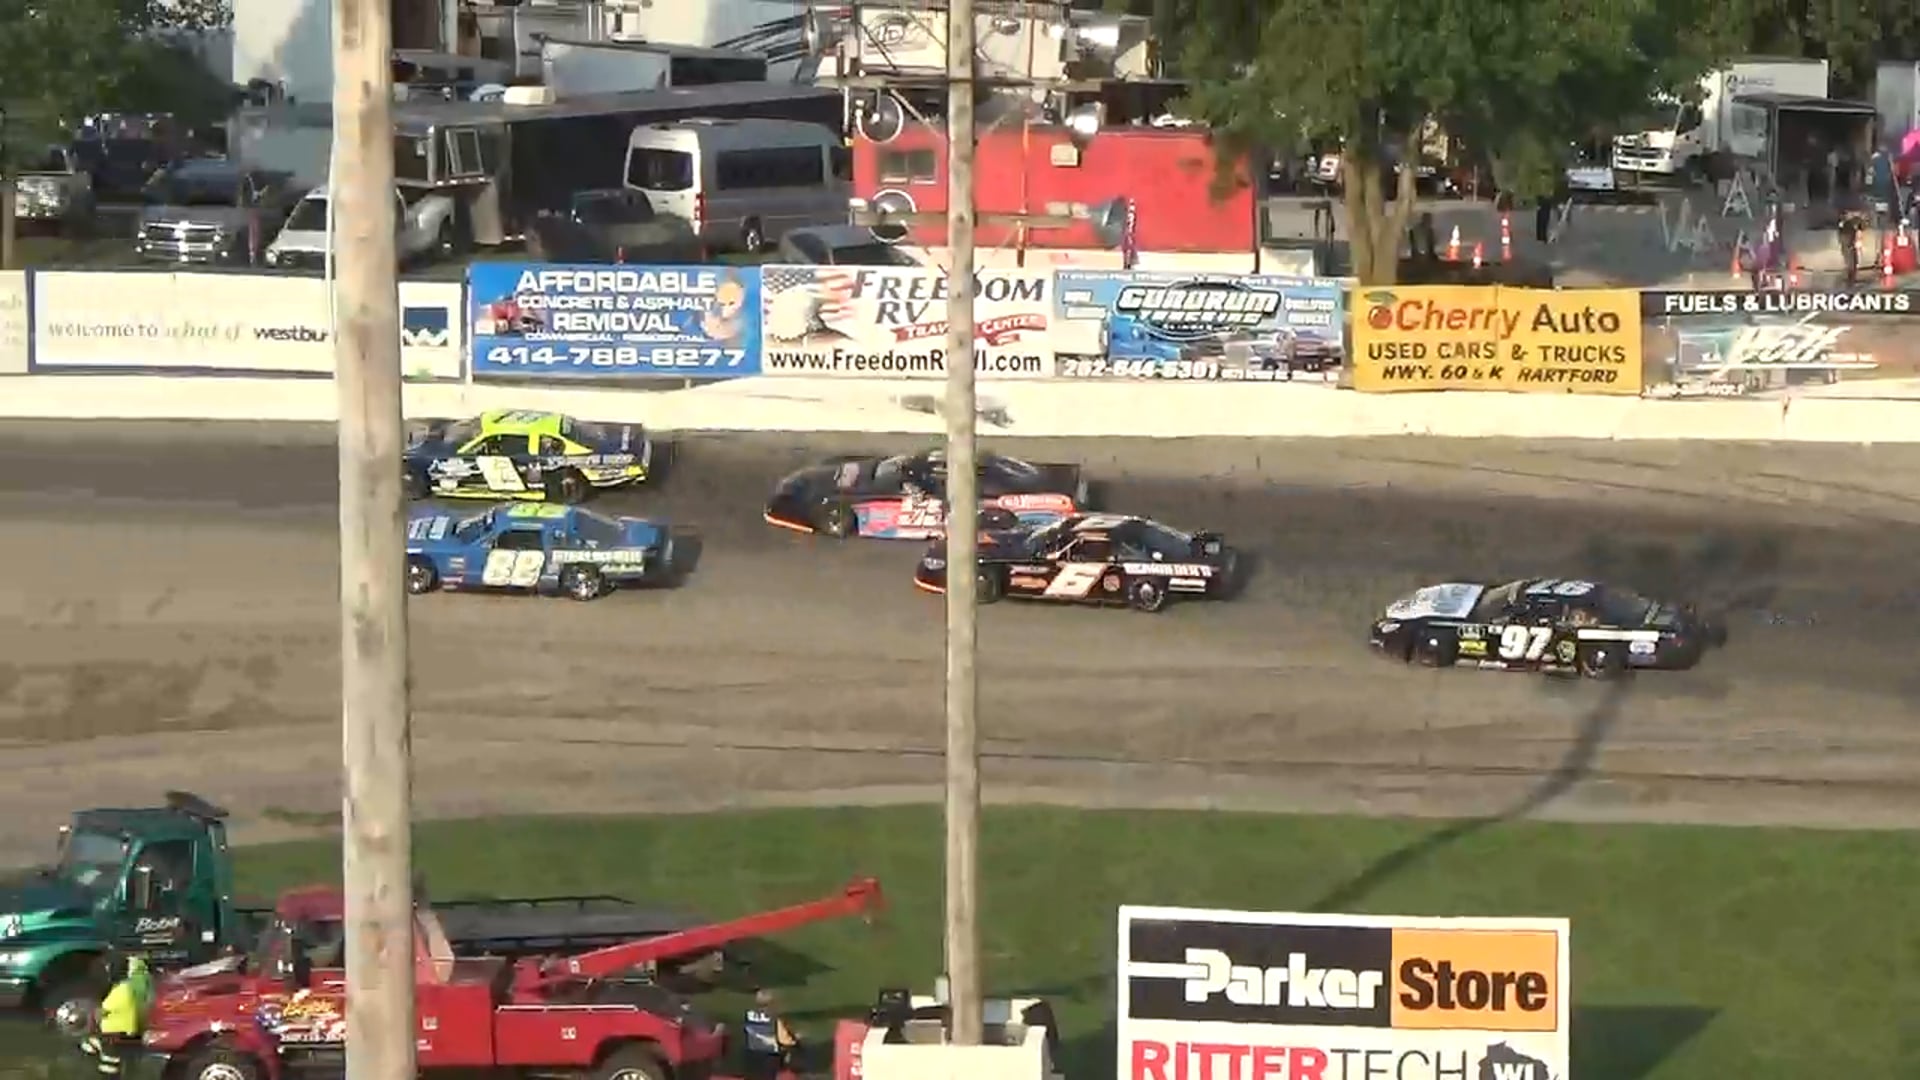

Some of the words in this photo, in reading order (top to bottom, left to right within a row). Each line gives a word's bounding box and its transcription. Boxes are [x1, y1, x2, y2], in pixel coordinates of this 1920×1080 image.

[517, 270, 717, 294] AFFORDABLE
[517, 295, 614, 310] CONCRETE
[617, 296, 630, 310] &
[631, 297, 714, 312] ASPHALT
[1118, 286, 1281, 313] GUNDRUM
[1665, 294, 1738, 313] FUELS
[1743, 294, 1759, 312] &
[1765, 292, 1910, 312] LUBRICANTS
[553, 312, 680, 333] REMOVAL
[875, 300, 930, 325] RV
[1396, 300, 1521, 339] Cherry
[1531, 303, 1621, 334] Auto
[254, 325, 334, 343] westbur
[1368, 342, 1427, 360] USED
[1437, 342, 1496, 360] CARS
[1511, 344, 1529, 361] &
[1540, 345, 1626, 363] TRUCKS
[1382, 365, 1434, 380] HWY.
[1441, 365, 1468, 379] 60
[1488, 366, 1505, 379] K
[1518, 367, 1619, 384] HARTFORD
[1045, 562, 1107, 596] 6
[1498, 624, 1553, 662] 97
[1185, 947, 1384, 1009] Parker
[1399, 957, 1548, 1012] Store
